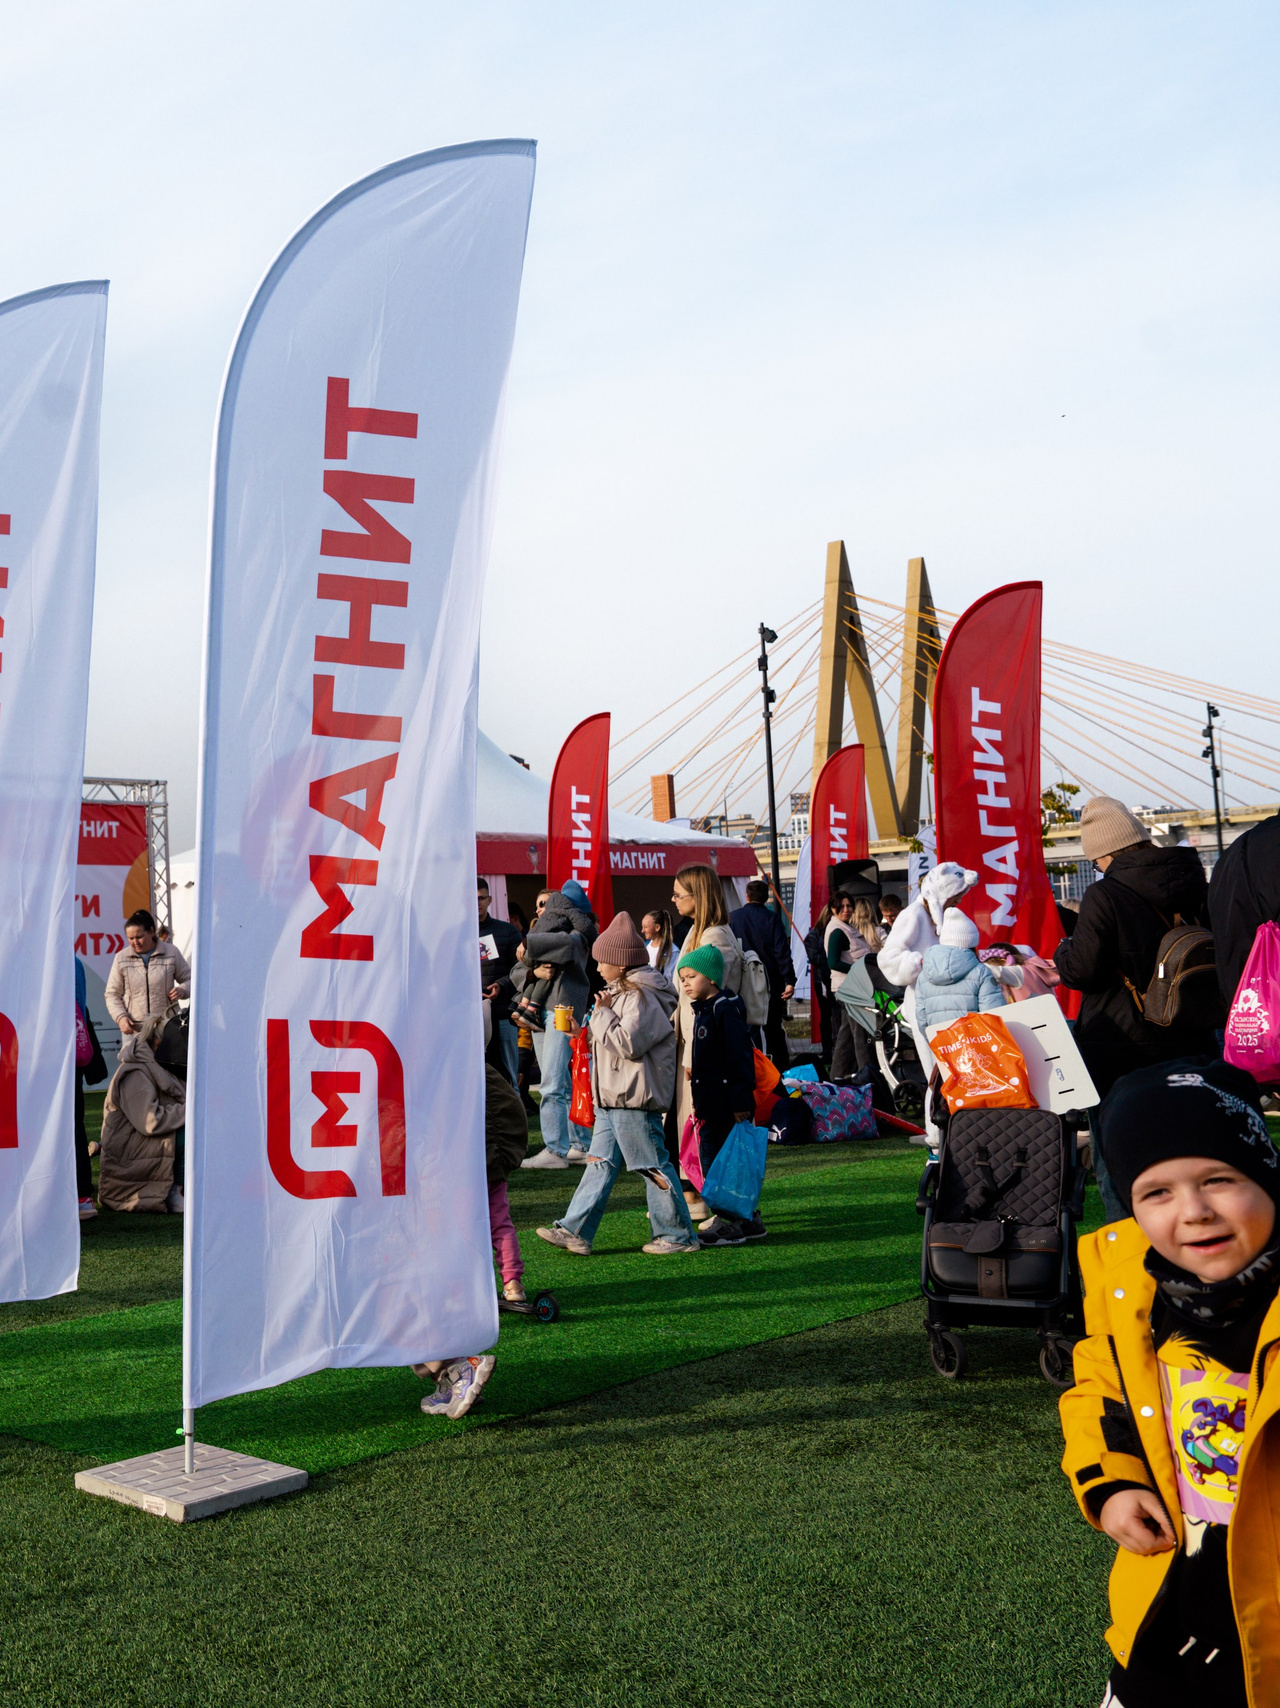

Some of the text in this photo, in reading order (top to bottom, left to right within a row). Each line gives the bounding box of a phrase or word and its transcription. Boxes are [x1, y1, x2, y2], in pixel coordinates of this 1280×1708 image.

[300, 376, 418, 961] МАГНИТ
[571, 785, 592, 895] ГНИТ
[971, 686, 1020, 927] МАГНИТ
[610, 852, 666, 870] МАГНИТ
[75, 894, 101, 918] И
[1237, 1034, 1258, 1046] 2025
